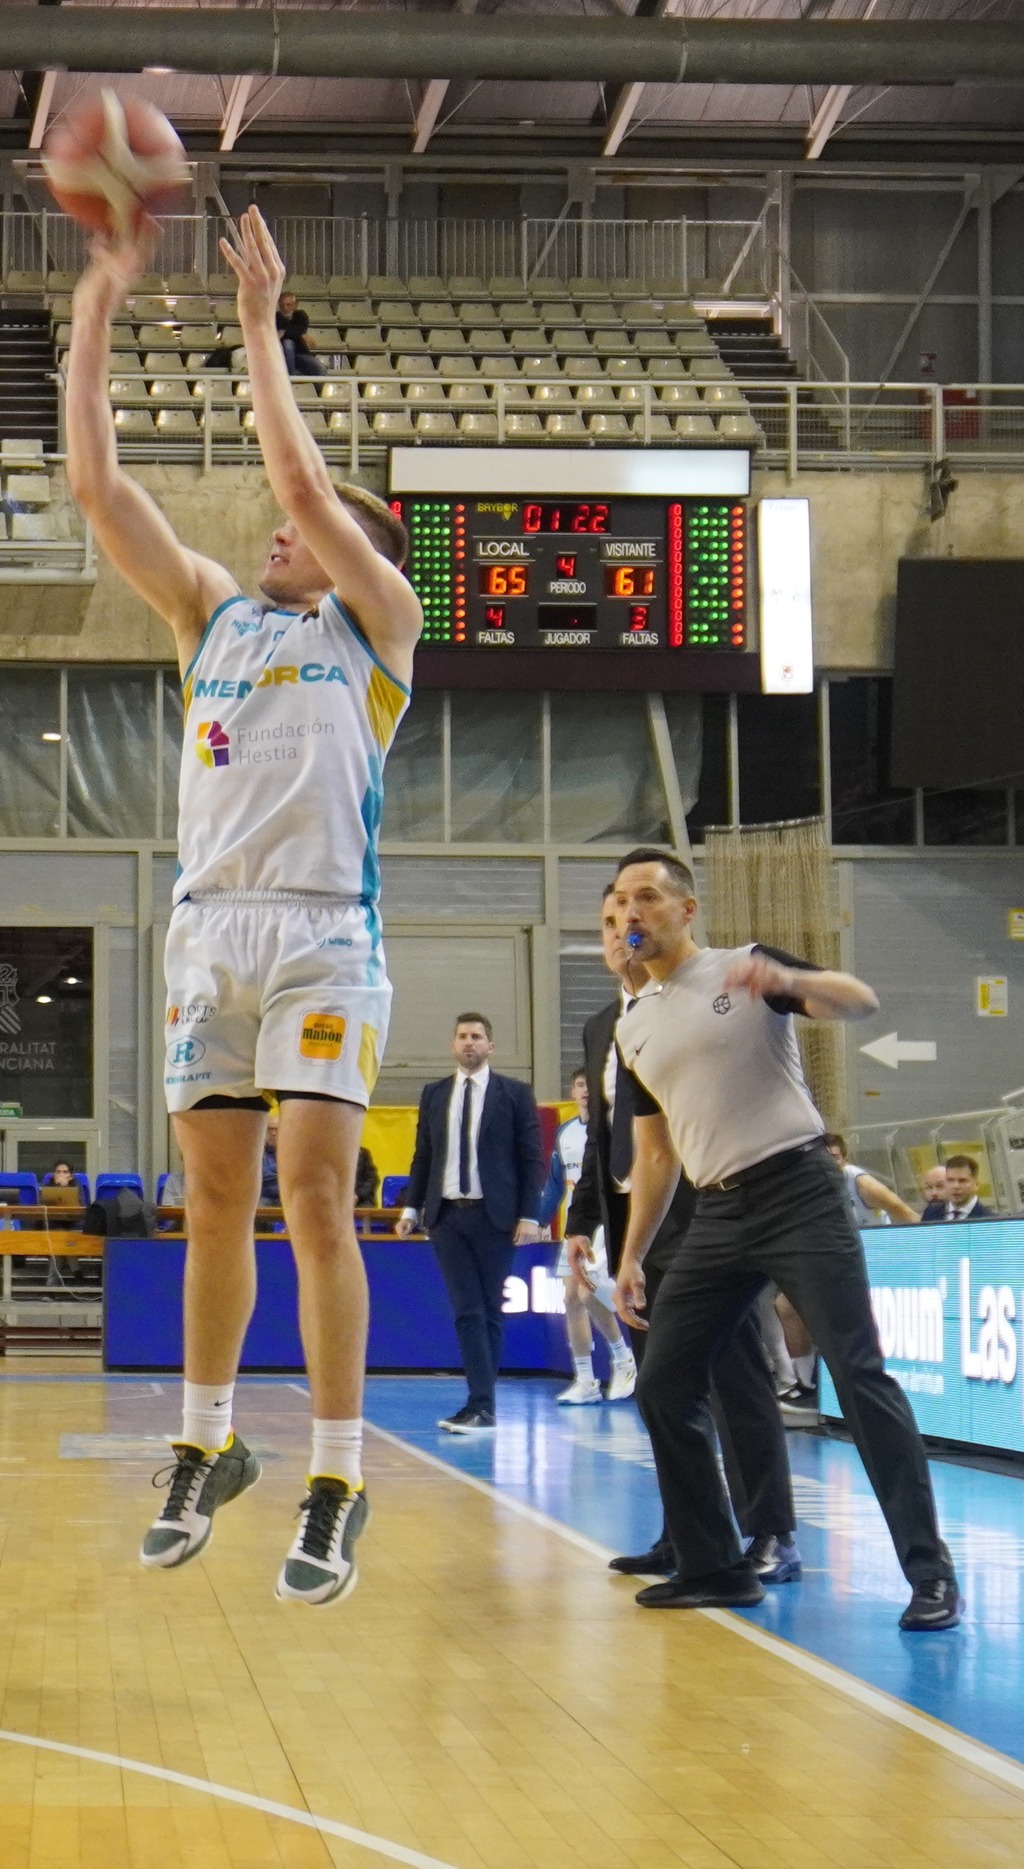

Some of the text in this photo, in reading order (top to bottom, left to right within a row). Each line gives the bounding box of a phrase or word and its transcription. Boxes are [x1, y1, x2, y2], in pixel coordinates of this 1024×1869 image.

[479, 542, 530, 557] LOCAL
[606, 543, 657, 557] VISITANTE
[557, 557, 576, 578] 4
[489, 566, 526, 595] 65
[550, 582, 587, 594] PERIODO
[615, 566, 654, 597] 61
[487, 607, 504, 629] 4
[630, 606, 648, 631] 3
[478, 632, 515, 645] FALTAS
[544, 633, 591, 645] JUGADOR
[622, 633, 659, 645] FALTAS
[236, 717, 335, 744] Fundación
[238, 746, 298, 765] Hestia
